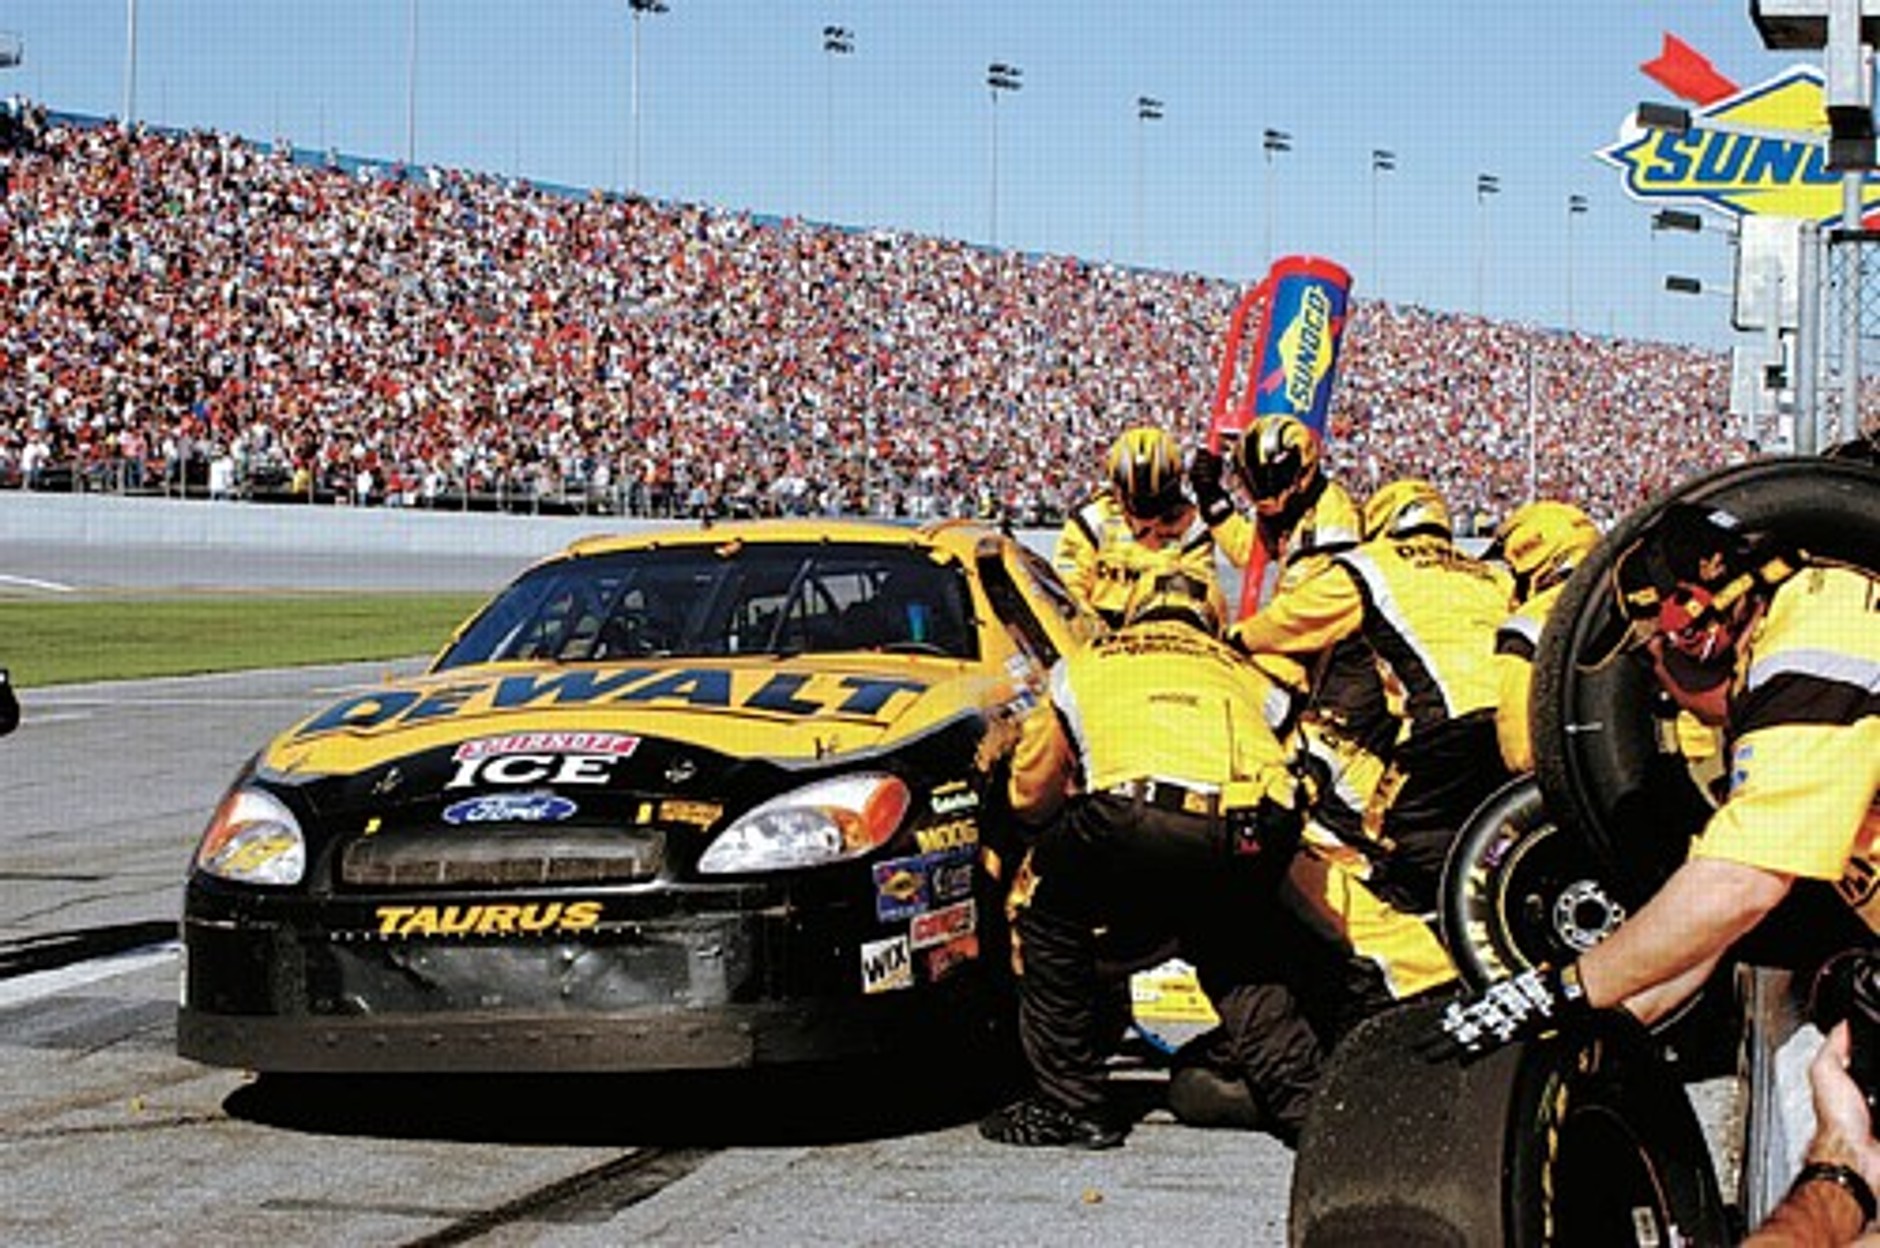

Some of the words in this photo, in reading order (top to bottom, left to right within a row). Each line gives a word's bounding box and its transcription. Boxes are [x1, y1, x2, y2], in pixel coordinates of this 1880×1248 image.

[1290, 290, 1326, 410] SUNOCO
[444, 754, 619, 789] ICE
[465, 801, 550, 820] Ford
[916, 820, 979, 853] MOOG
[375, 901, 603, 934] TAURUS
